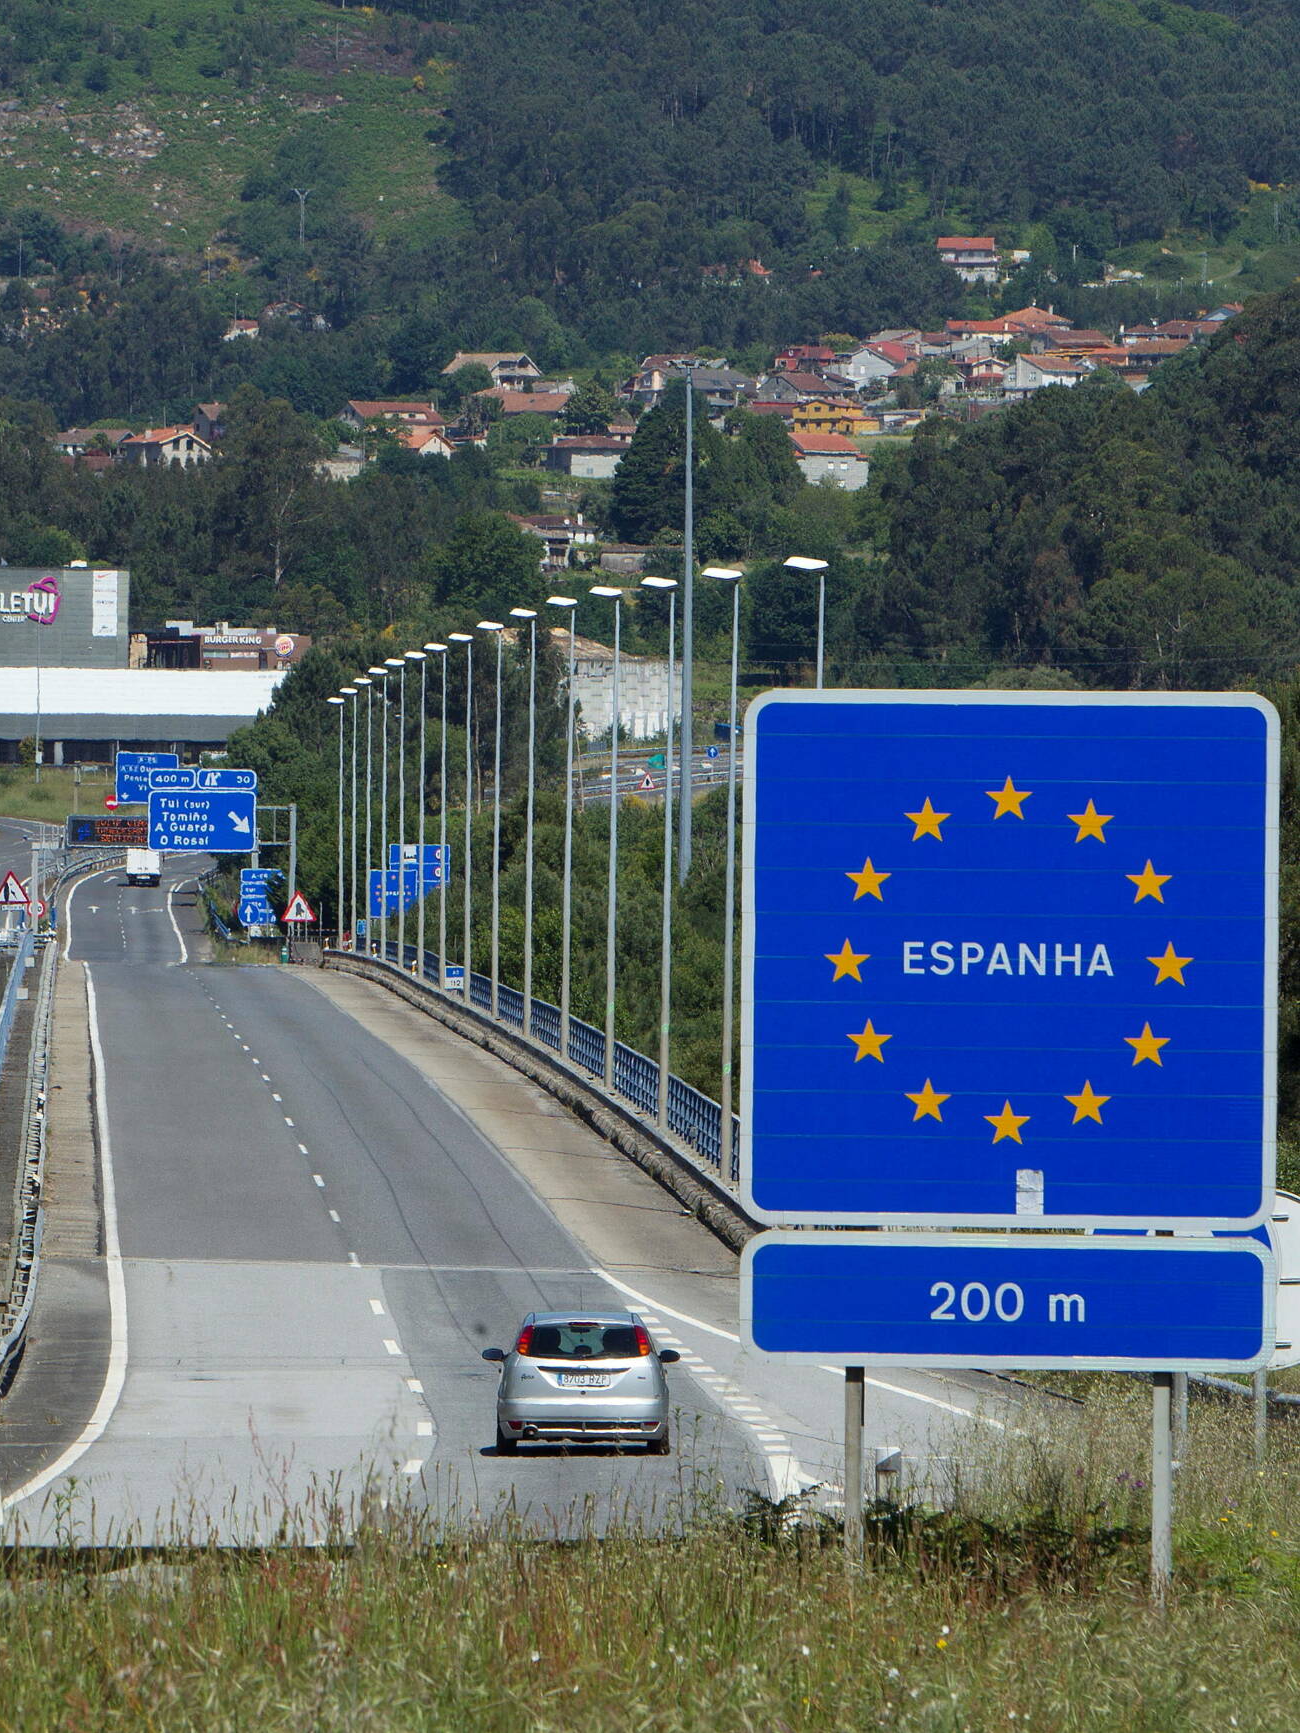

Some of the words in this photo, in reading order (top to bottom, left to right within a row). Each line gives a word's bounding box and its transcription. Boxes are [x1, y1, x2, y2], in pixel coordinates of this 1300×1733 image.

[204, 636, 239, 645] BURGER
[239, 636, 262, 645] KING
[155, 774, 177, 783] 400
[236, 776, 251, 784] 30
[159, 798, 179, 808] Tui
[184, 799, 210, 810] (sur)
[161, 812, 208, 821] Tomiño
[155, 823, 164, 832] A
[170, 823, 215, 832] Guarda
[160, 835, 168, 845] O
[902, 940, 1116, 977] ESPANHA
[929, 1281, 1025, 1323] 200
[1049, 1293, 1086, 1323] m
